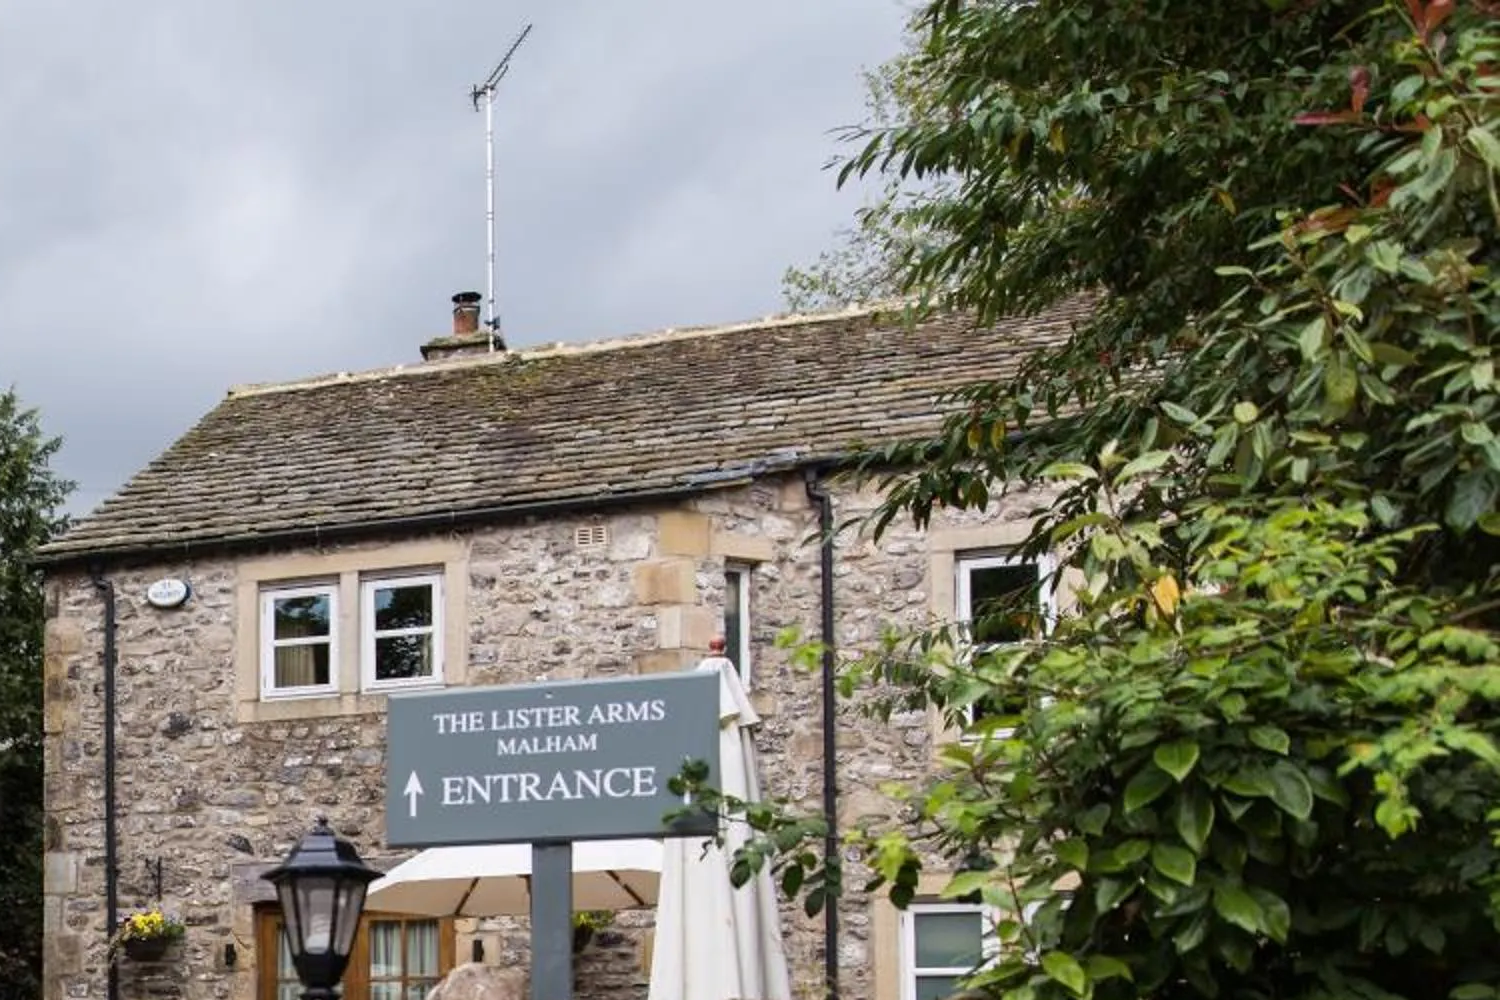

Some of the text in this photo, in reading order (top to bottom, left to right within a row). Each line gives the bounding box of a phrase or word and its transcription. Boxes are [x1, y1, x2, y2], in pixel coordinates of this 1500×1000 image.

[433, 700, 665, 734] THE LISTER ARMS
[497, 734, 598, 756] MALHAM
[441, 767, 657, 805] ENTRANCE
